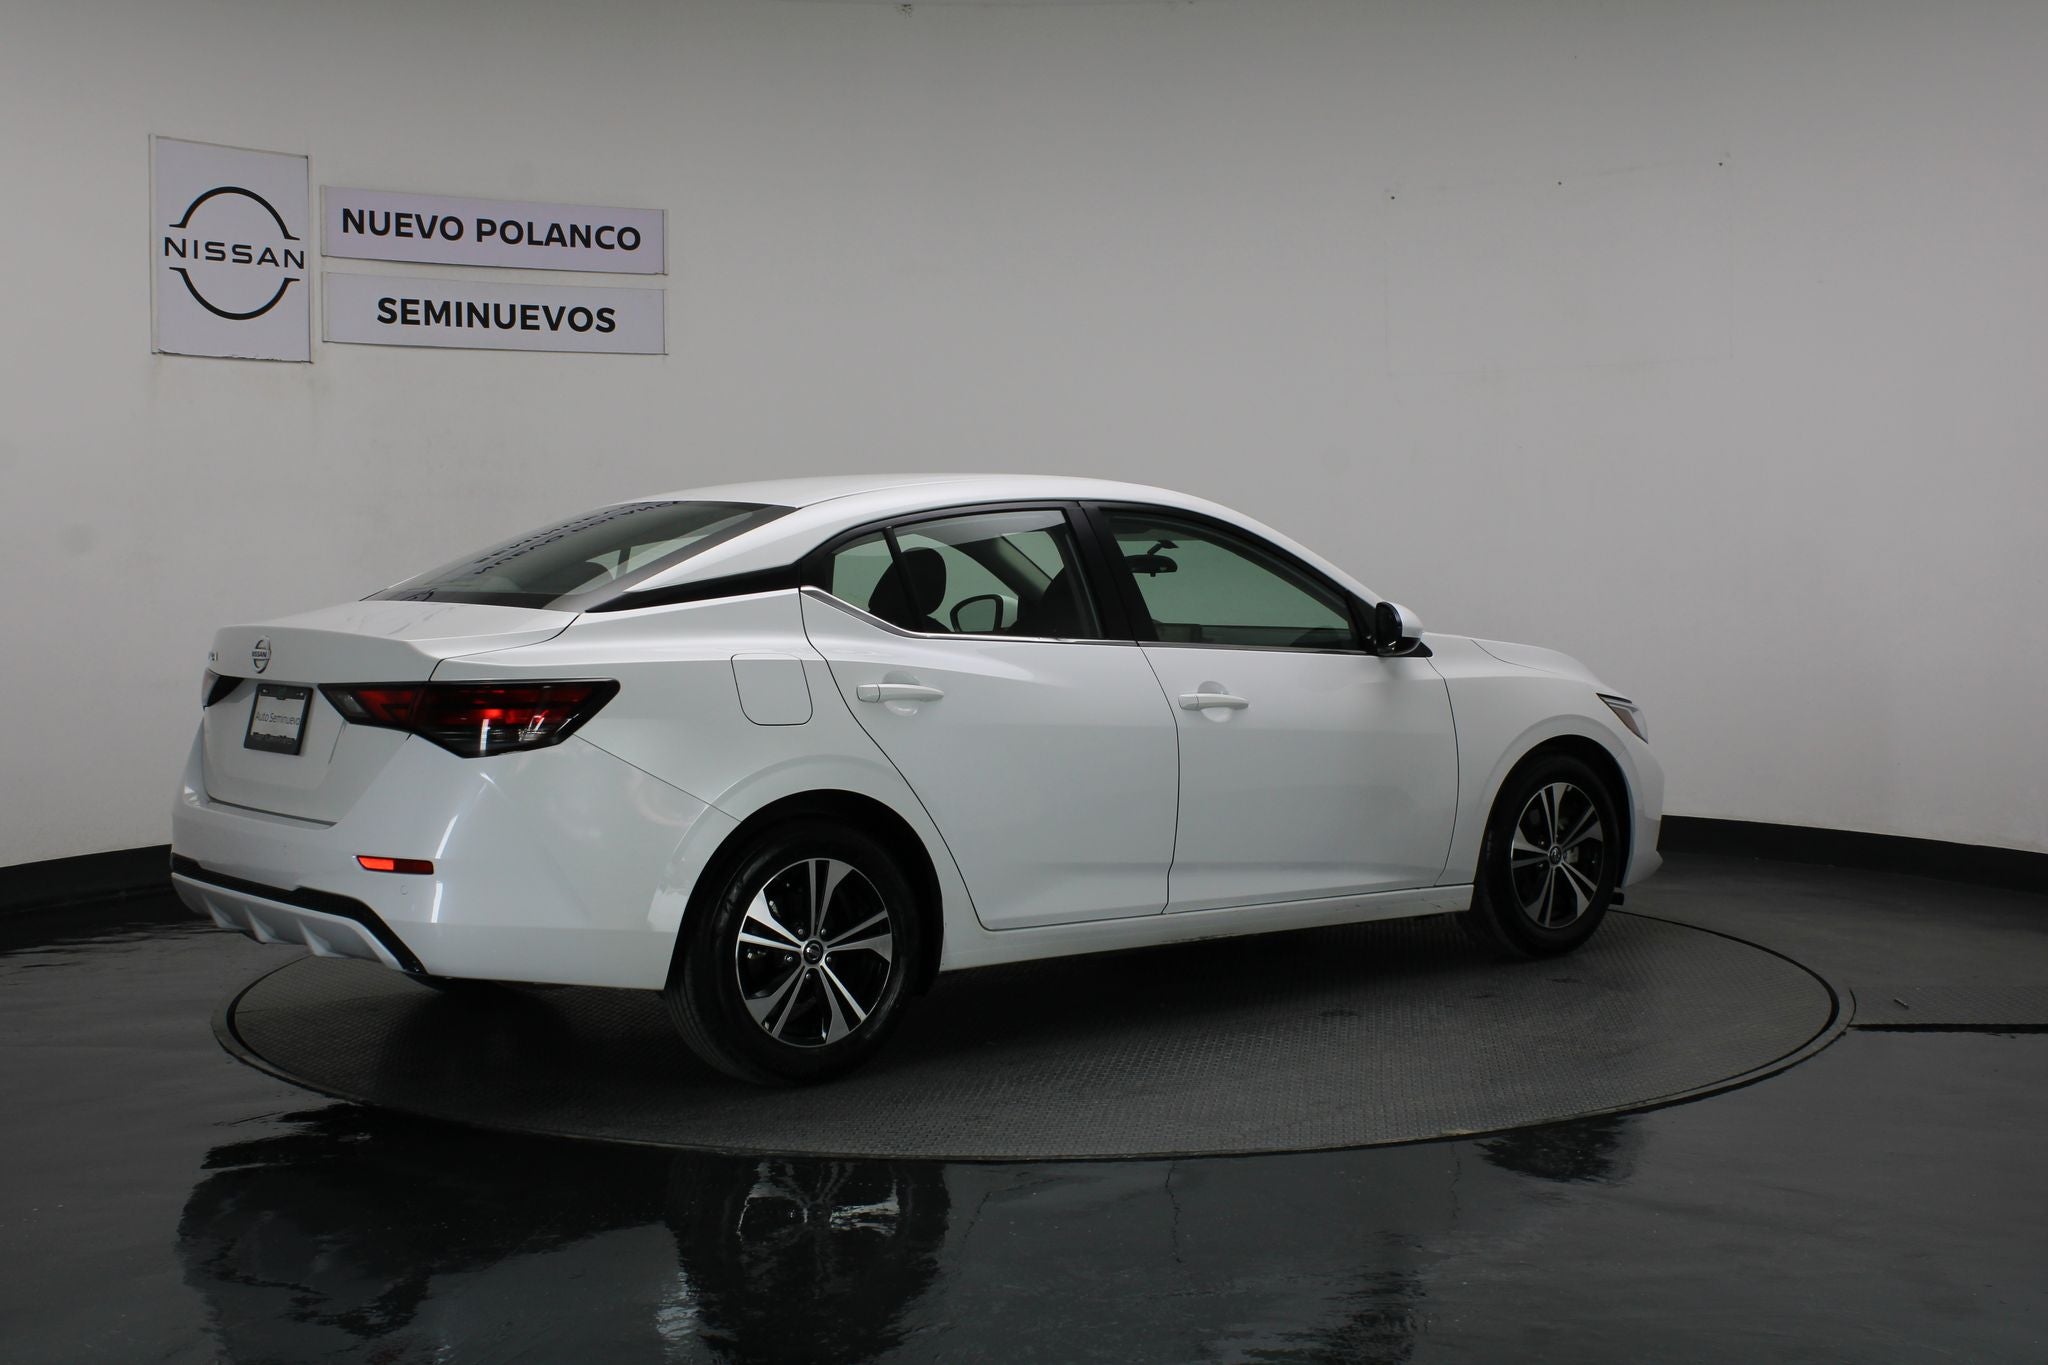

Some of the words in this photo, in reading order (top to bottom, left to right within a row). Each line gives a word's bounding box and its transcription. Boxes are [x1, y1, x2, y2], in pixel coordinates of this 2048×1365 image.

[342, 207, 464, 241] NUEVO
[476, 218, 641, 251] POLANCO
[164, 236, 305, 270] NISSAN
[377, 297, 616, 333] SEMINUEVOS
[255, 711, 269, 722] Auto
